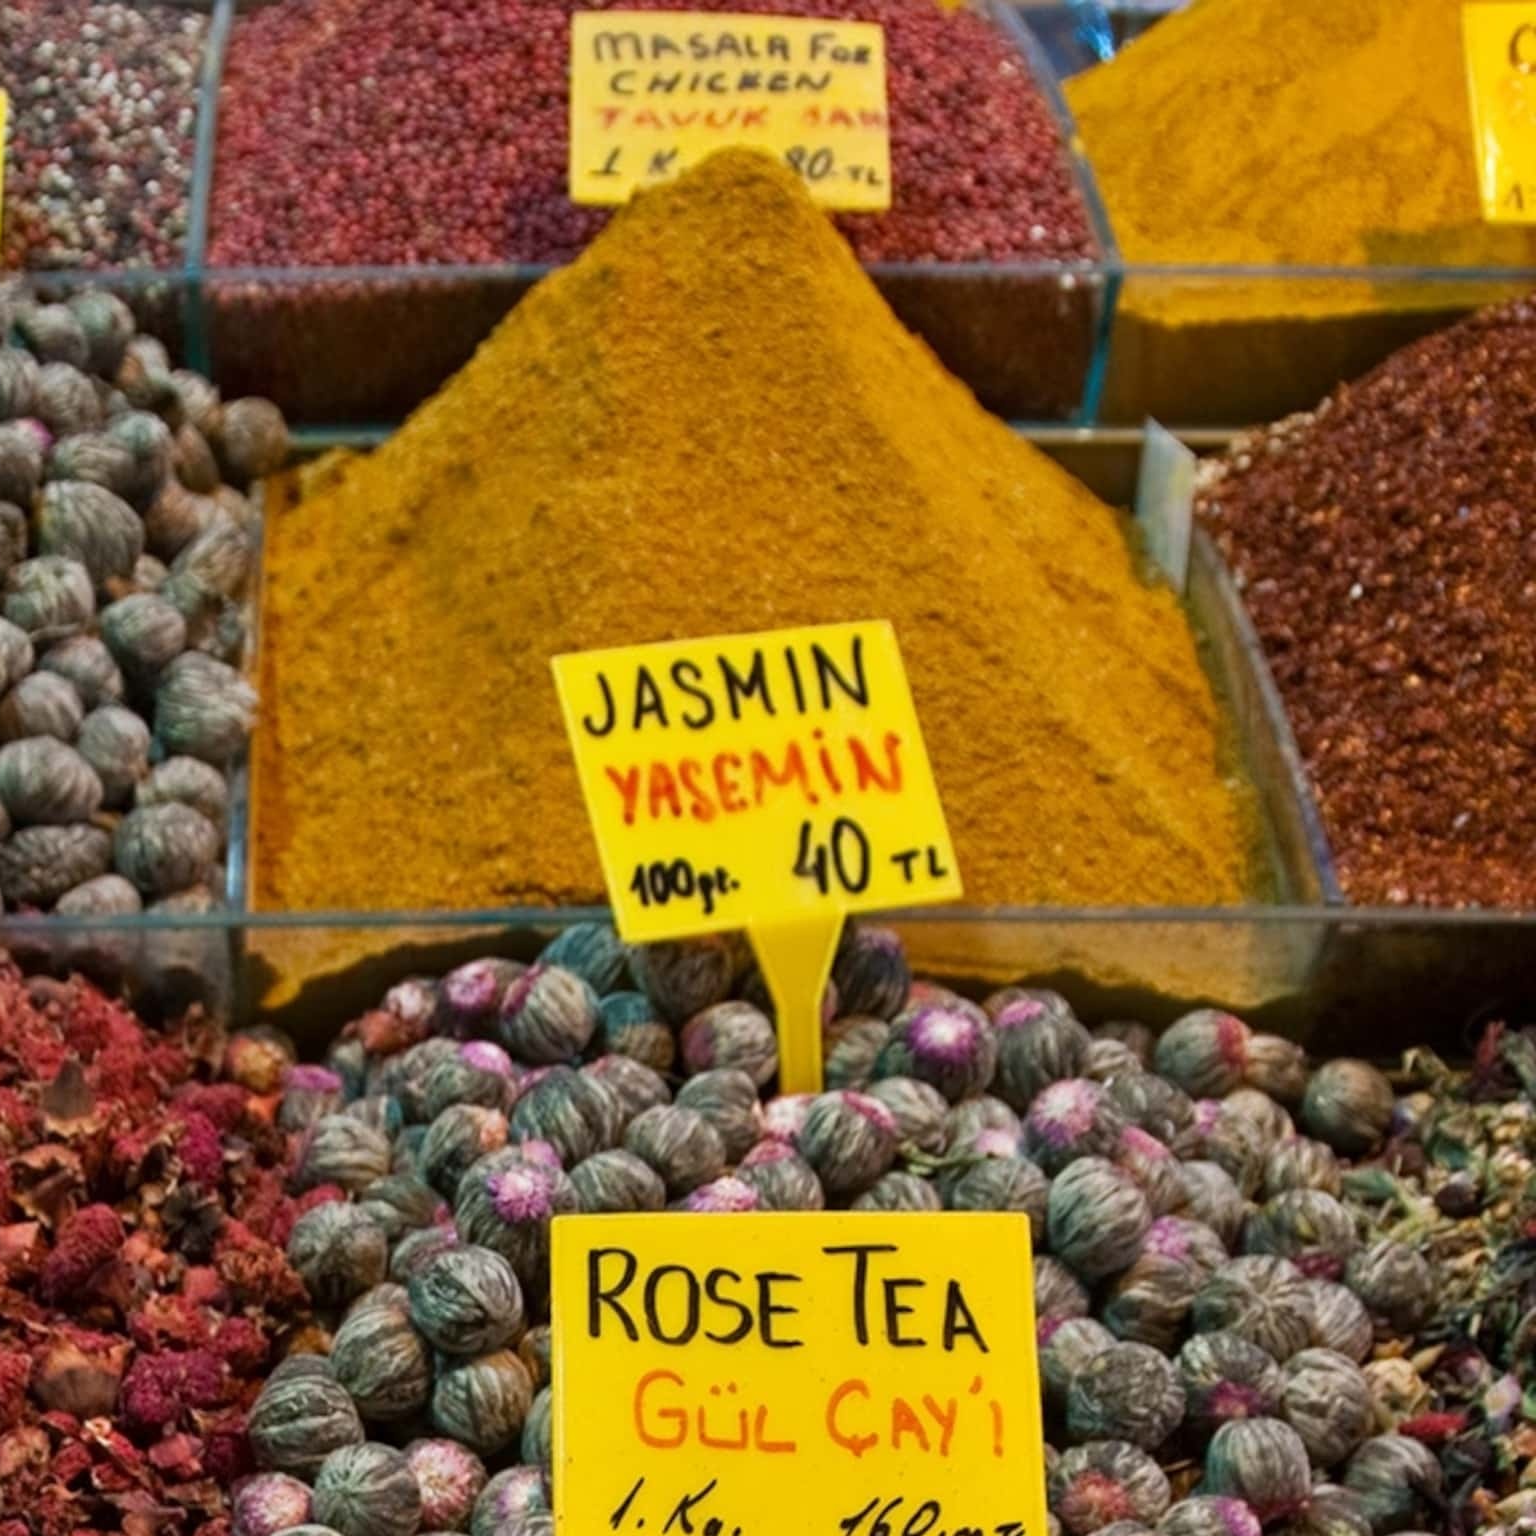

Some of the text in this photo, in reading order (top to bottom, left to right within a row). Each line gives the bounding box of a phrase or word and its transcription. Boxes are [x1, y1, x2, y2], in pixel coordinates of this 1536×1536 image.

[594, 31, 791, 62] MASALA
[610, 70, 831, 95] CHICKEN
[594, 105, 769, 129] TAVUK
[583, 634, 870, 737] JASMIN
[793, 816, 872, 895] 40
[891, 845, 948, 883] TL
[587, 1244, 990, 1354] ROSE TEA
[633, 1368, 797, 1453] GÜL
